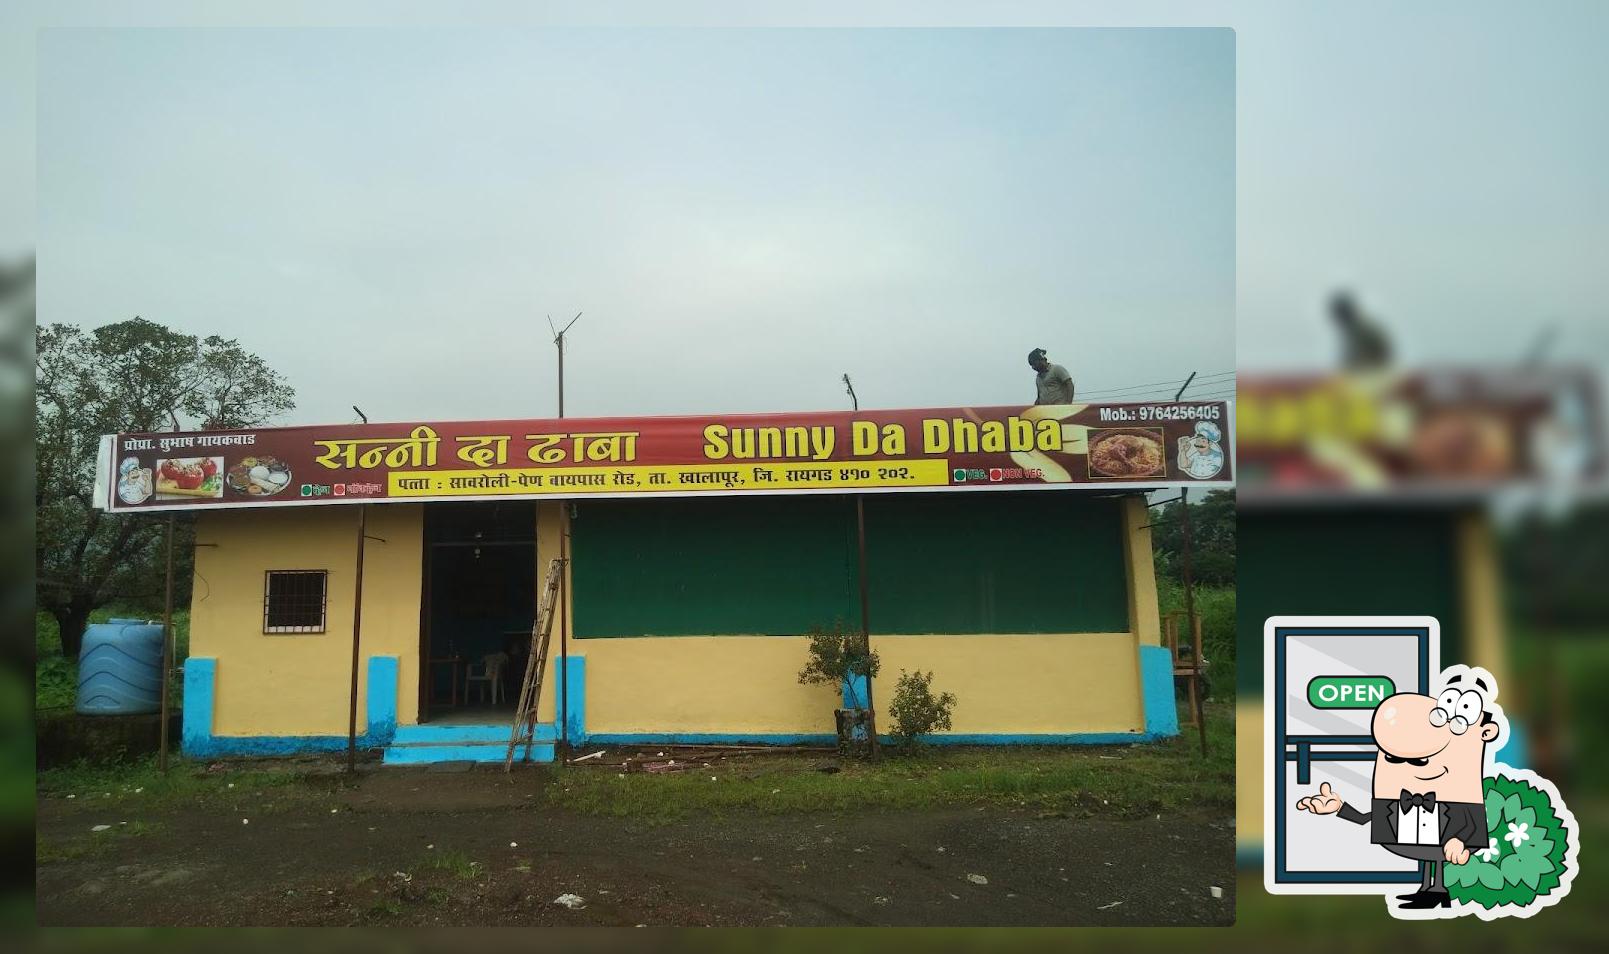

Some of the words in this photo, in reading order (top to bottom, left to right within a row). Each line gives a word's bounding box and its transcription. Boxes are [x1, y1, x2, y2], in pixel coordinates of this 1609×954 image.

[1100, 407, 1136, 421] Mob.:
[1139, 405, 1220, 420] 9764256405
[159, 436, 194, 453] सुभाष
[197, 434, 256, 447] गायकवाड
[314, 425, 441, 470] सन्नी
[455, 435, 511, 467] दा
[525, 431, 640, 465] ढाबा
[703, 423, 836, 460] Sunny
[852, 420, 907, 456] Da
[922, 416, 1062, 454] Dhaba
[612, 470, 641, 488] रोड,
[678, 471, 745, 488] खालापूर,
[785, 469, 833, 482] रायगड
[839, 468, 870, 481] ४१०
[1002, 467, 1023, 479] NON
